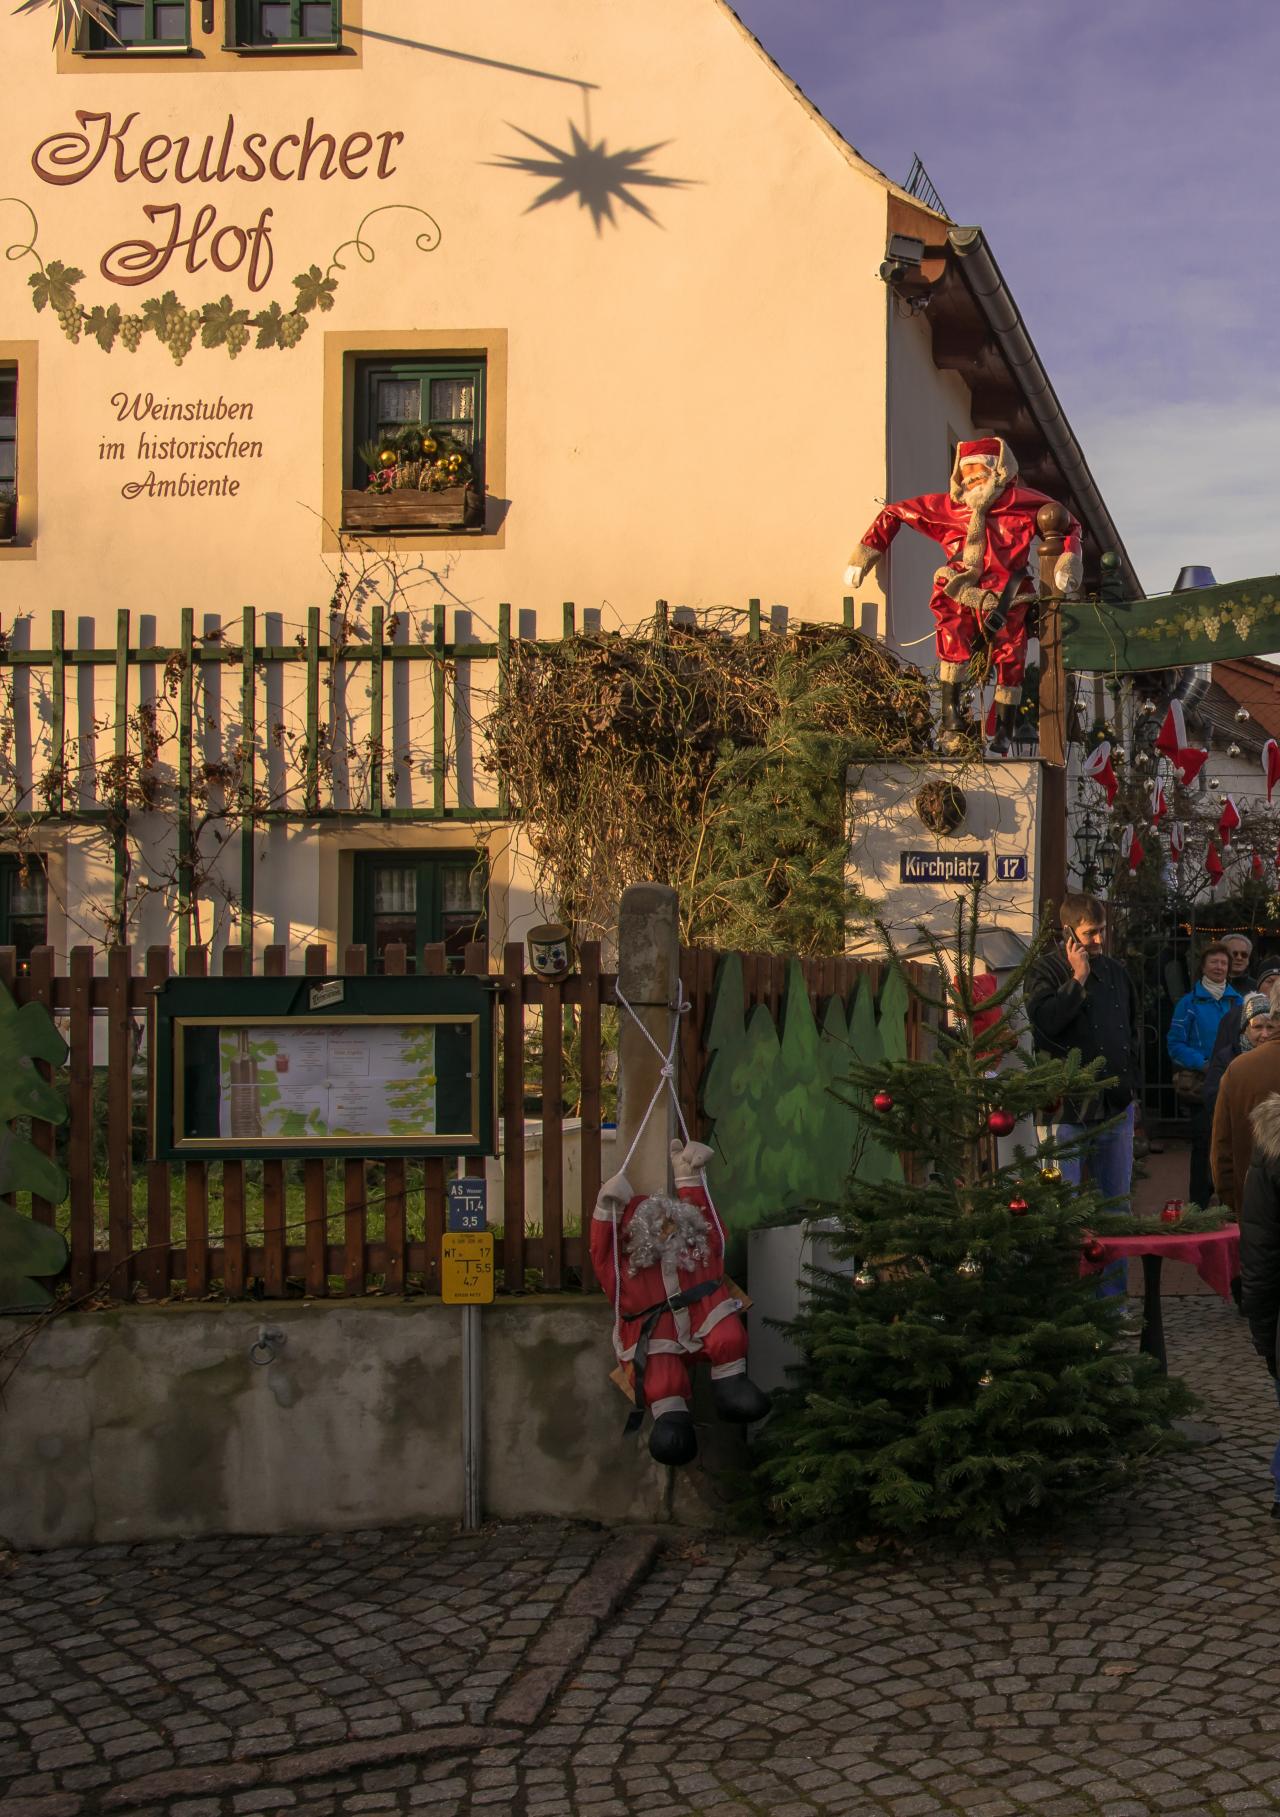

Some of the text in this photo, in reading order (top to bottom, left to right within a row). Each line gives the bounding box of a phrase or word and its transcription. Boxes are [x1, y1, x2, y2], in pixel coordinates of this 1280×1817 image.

[31, 110, 404, 186] Keulscher
[100, 203, 274, 292] Hof
[110, 392, 253, 421] Weinstuben
[99, 433, 263, 461] im historischen
[121, 472, 241, 500] Ambiente
[905, 856, 1020, 880] Kirchplatz 17
[451, 1185, 464, 1195] AS
[480, 1248, 491, 1258] 17
